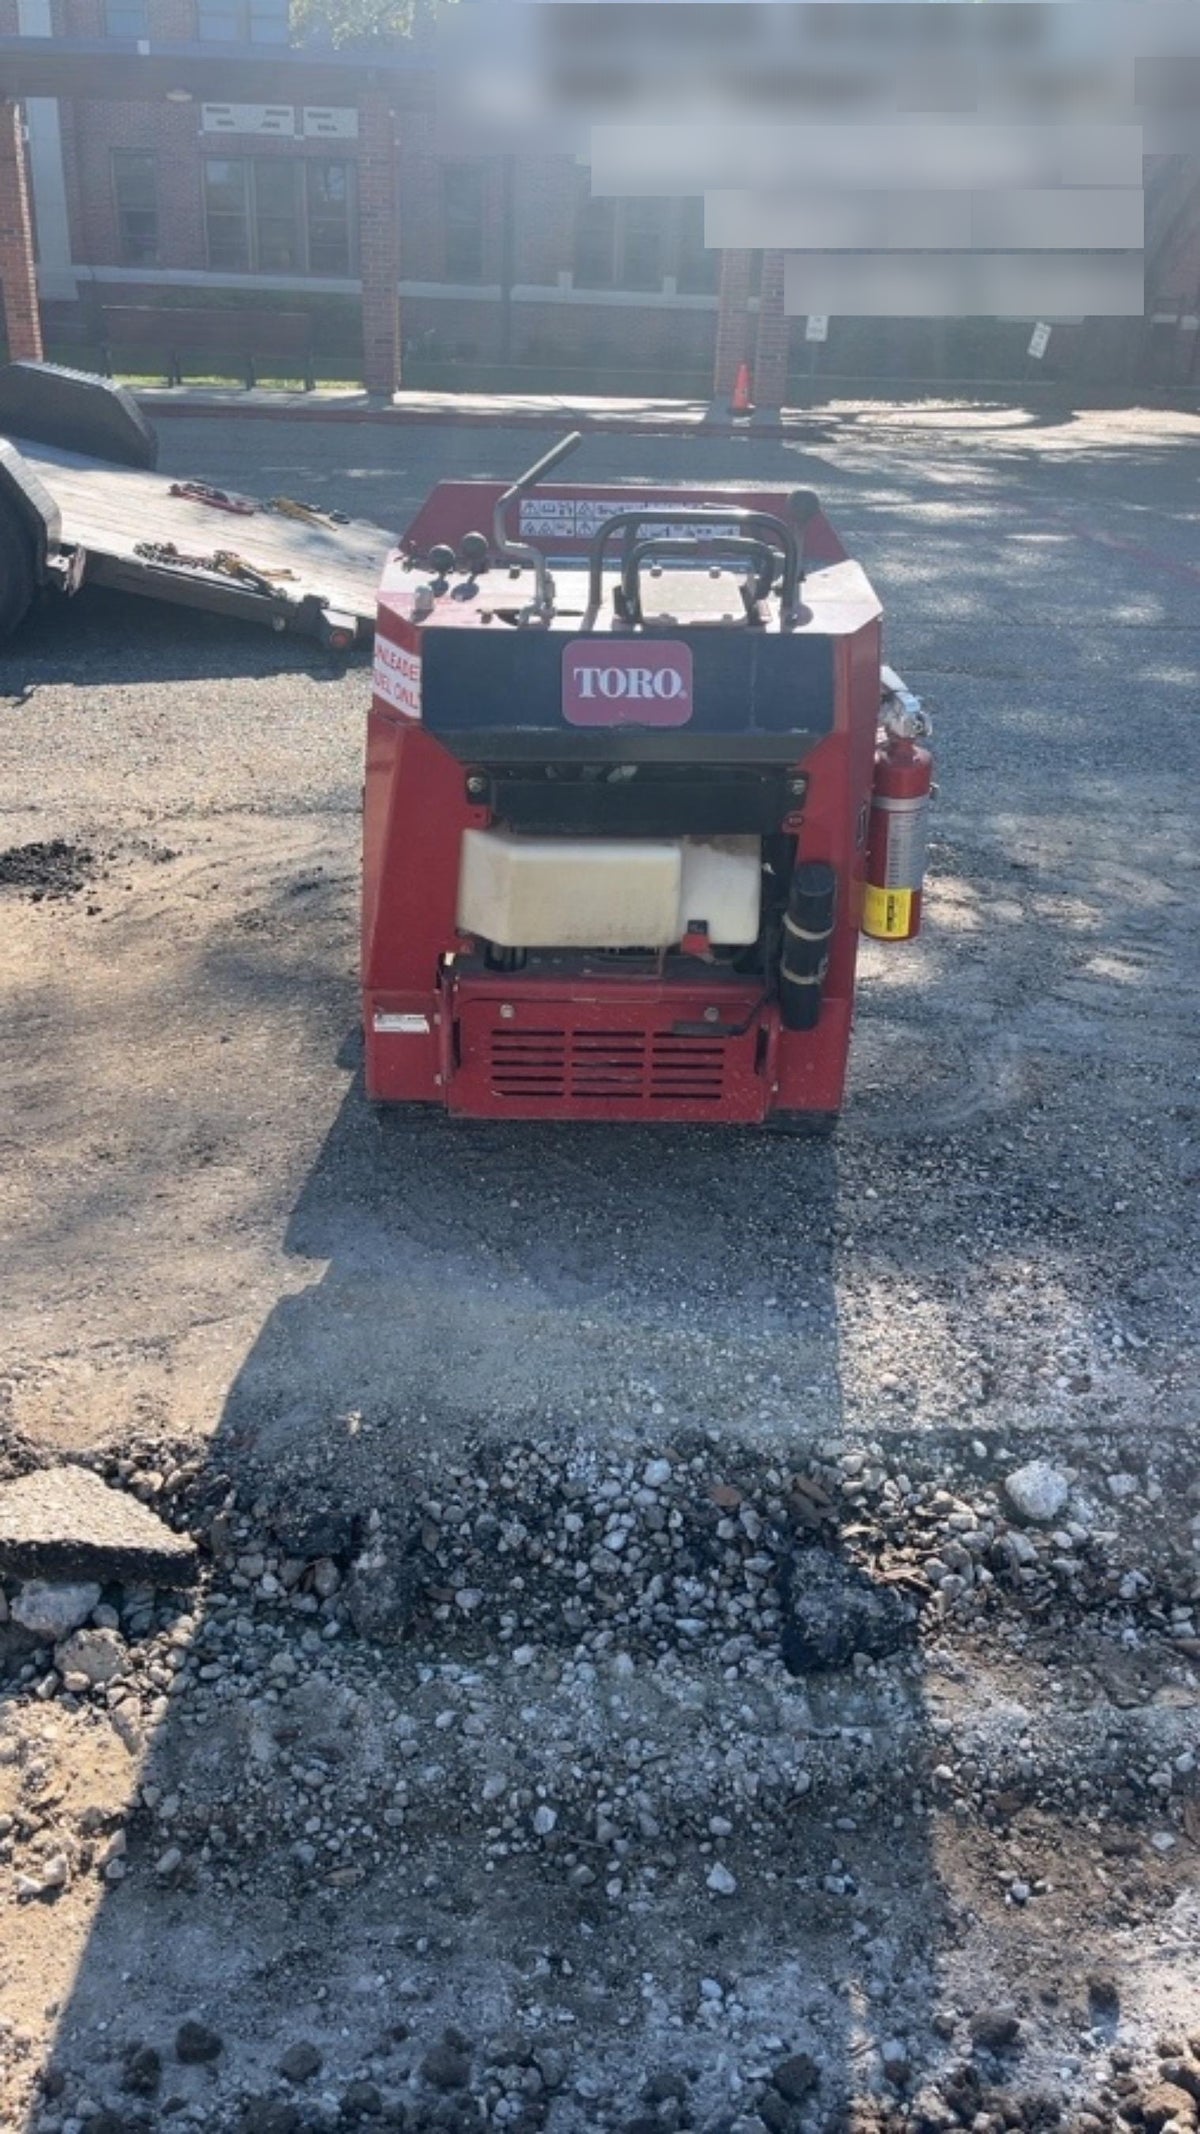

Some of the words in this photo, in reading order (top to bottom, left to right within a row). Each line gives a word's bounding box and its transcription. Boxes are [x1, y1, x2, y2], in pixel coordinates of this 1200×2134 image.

[376, 643, 420, 681] NLEADE
[374, 670, 393, 696] UEL
[394, 682, 419, 709] ONL
[573, 667, 682, 698] TORO
